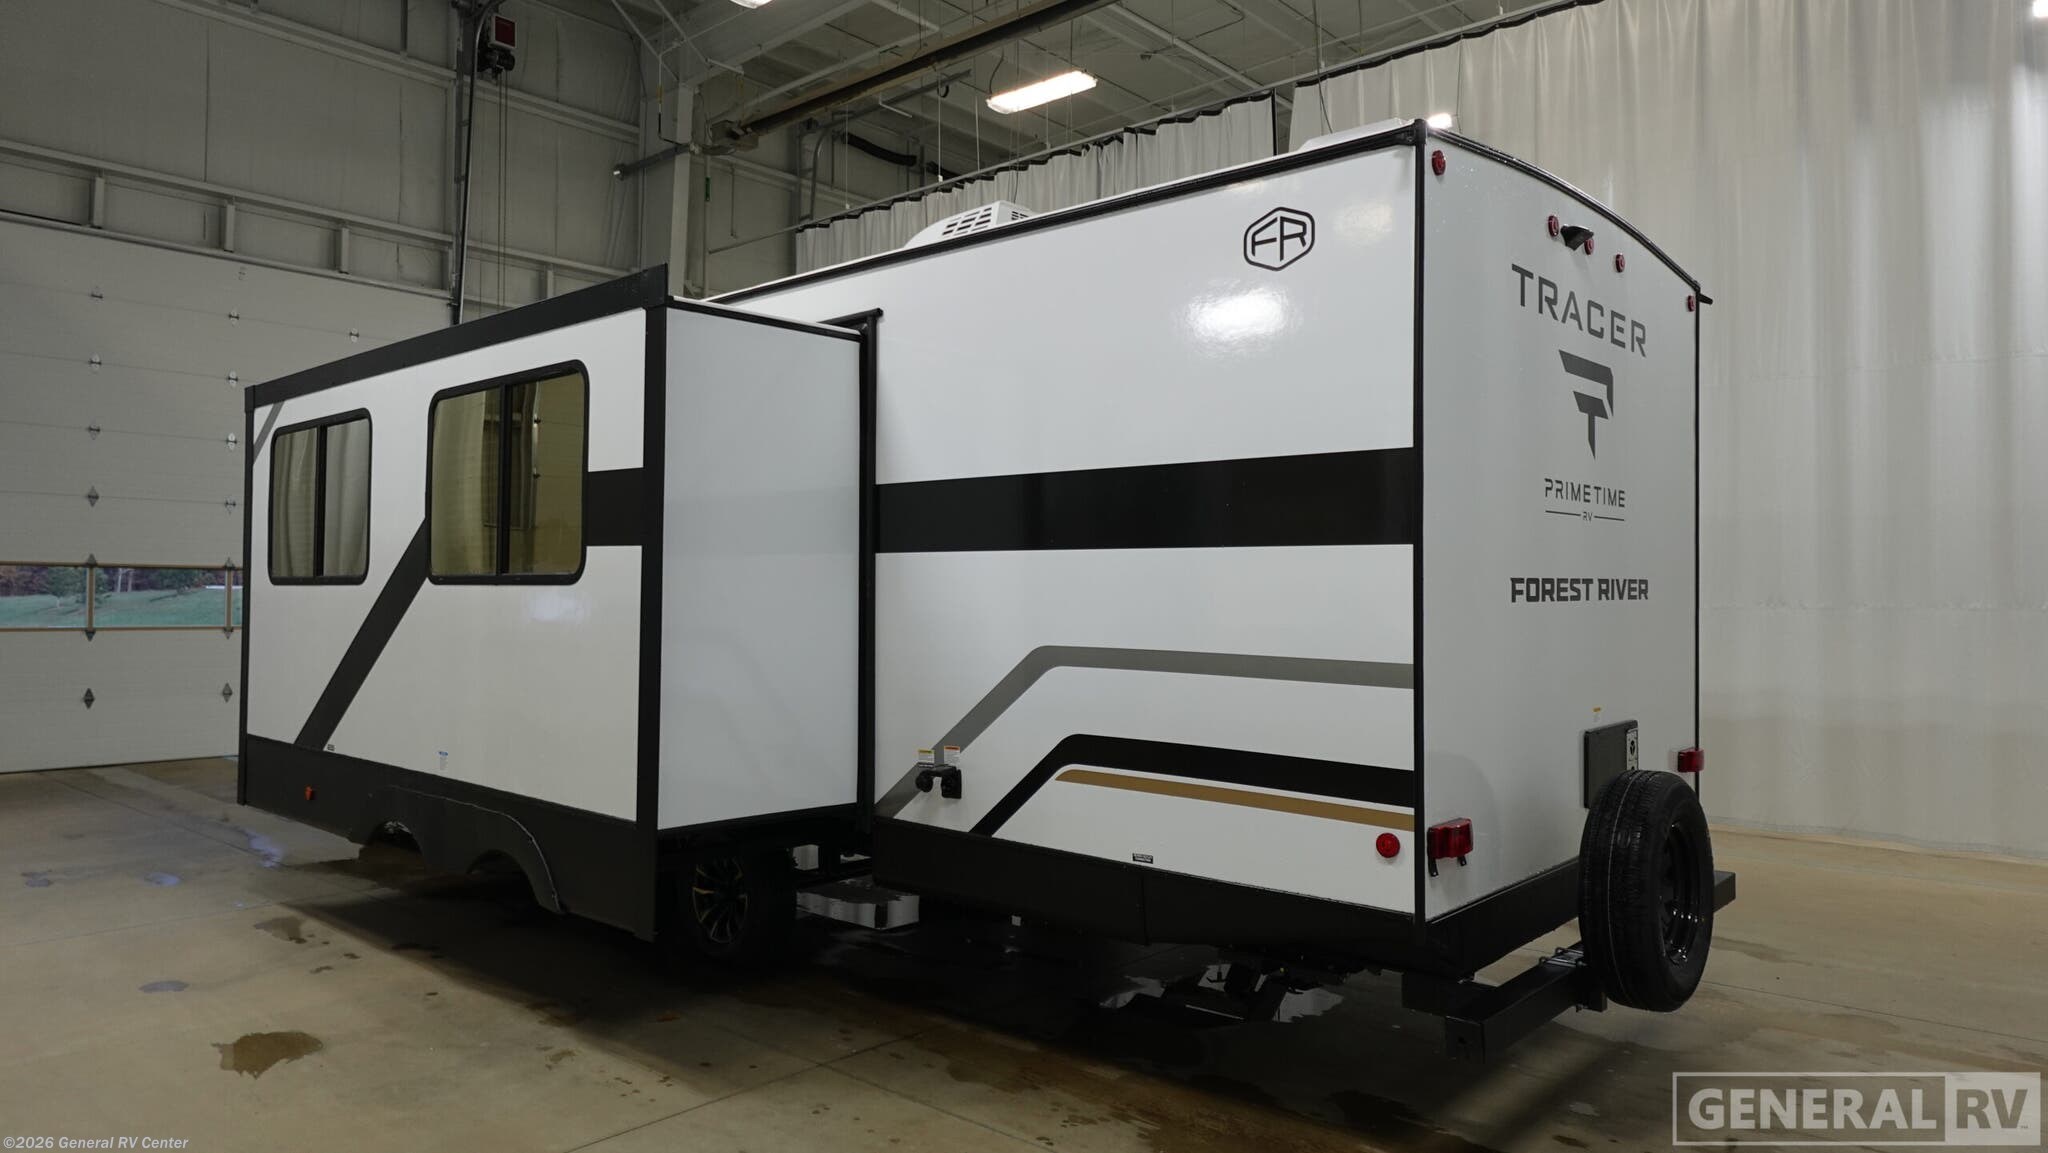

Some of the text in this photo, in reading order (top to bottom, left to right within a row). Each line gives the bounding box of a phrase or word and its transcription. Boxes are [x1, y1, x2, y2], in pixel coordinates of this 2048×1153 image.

[1512, 263, 1647, 357] TRACER
[1582, 511, 1593, 522] RV
[1510, 577, 1649, 603] FOREST RIVER
